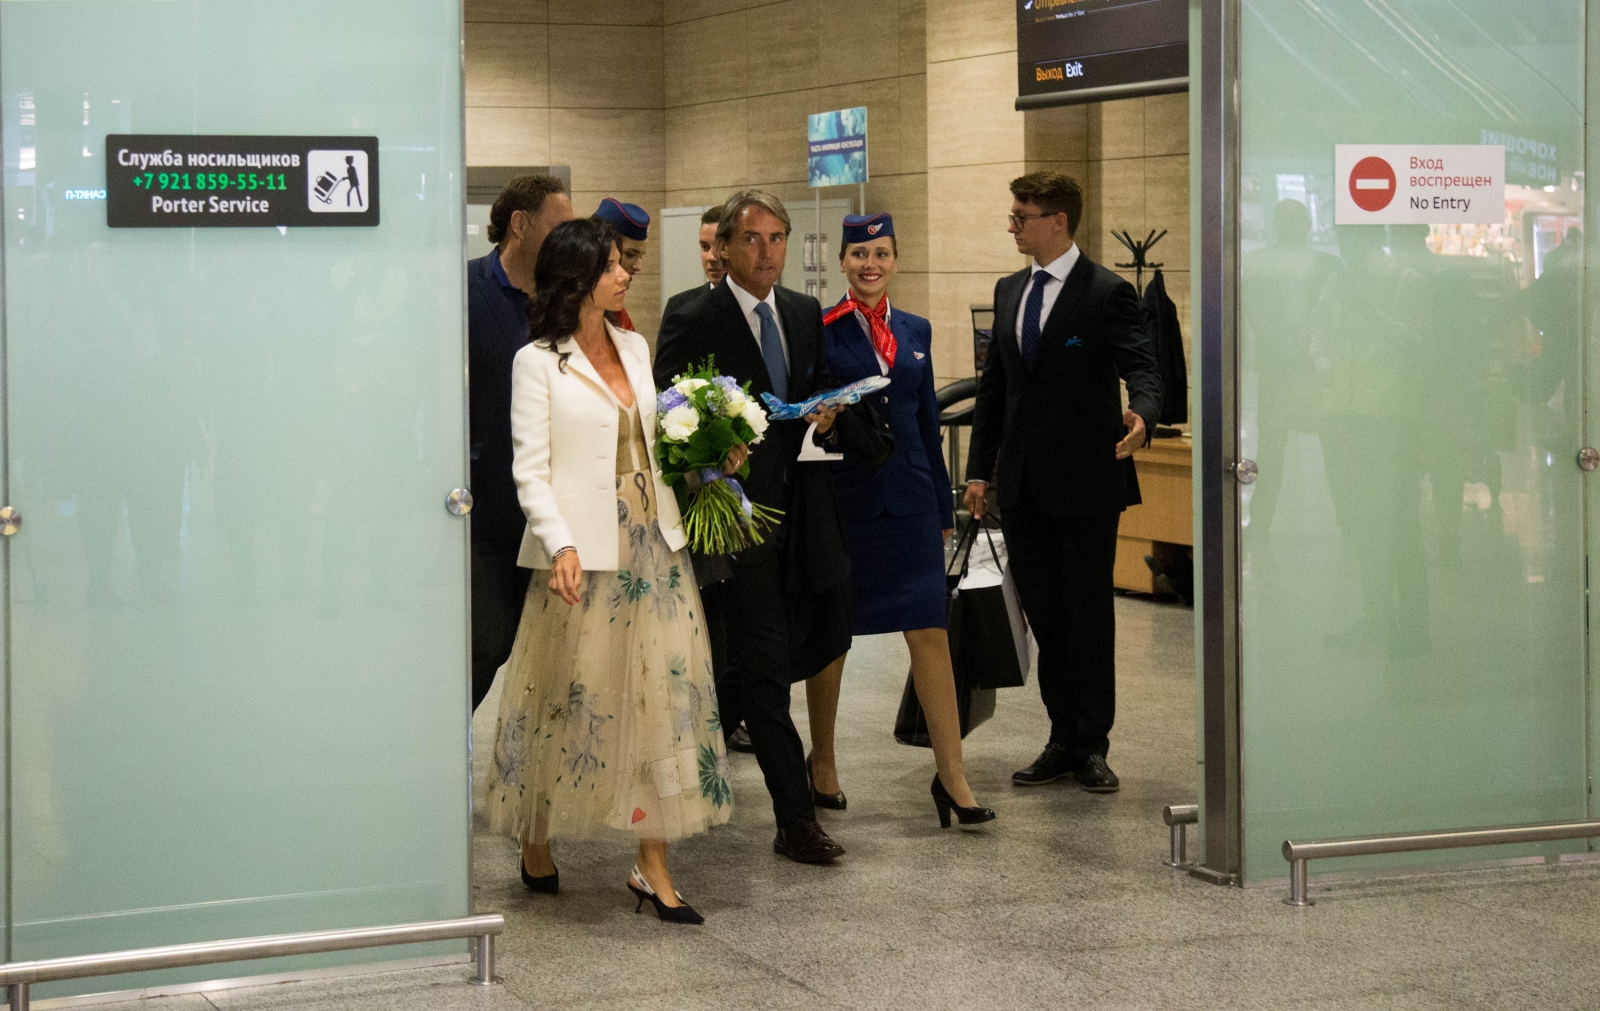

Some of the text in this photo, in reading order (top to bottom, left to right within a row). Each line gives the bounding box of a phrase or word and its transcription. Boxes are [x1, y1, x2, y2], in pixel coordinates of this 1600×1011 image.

[1035, 61, 1084, 82] Выход Exit
[117, 148, 301, 170] Служба носильщиков
[1409, 156, 1444, 171] Вход
[132, 172, 287, 191] +7 921 859-55-11
[1409, 175, 1492, 190] воспрещен
[151, 195, 270, 214] Porter Service
[1409, 196, 1471, 213] No Entry
